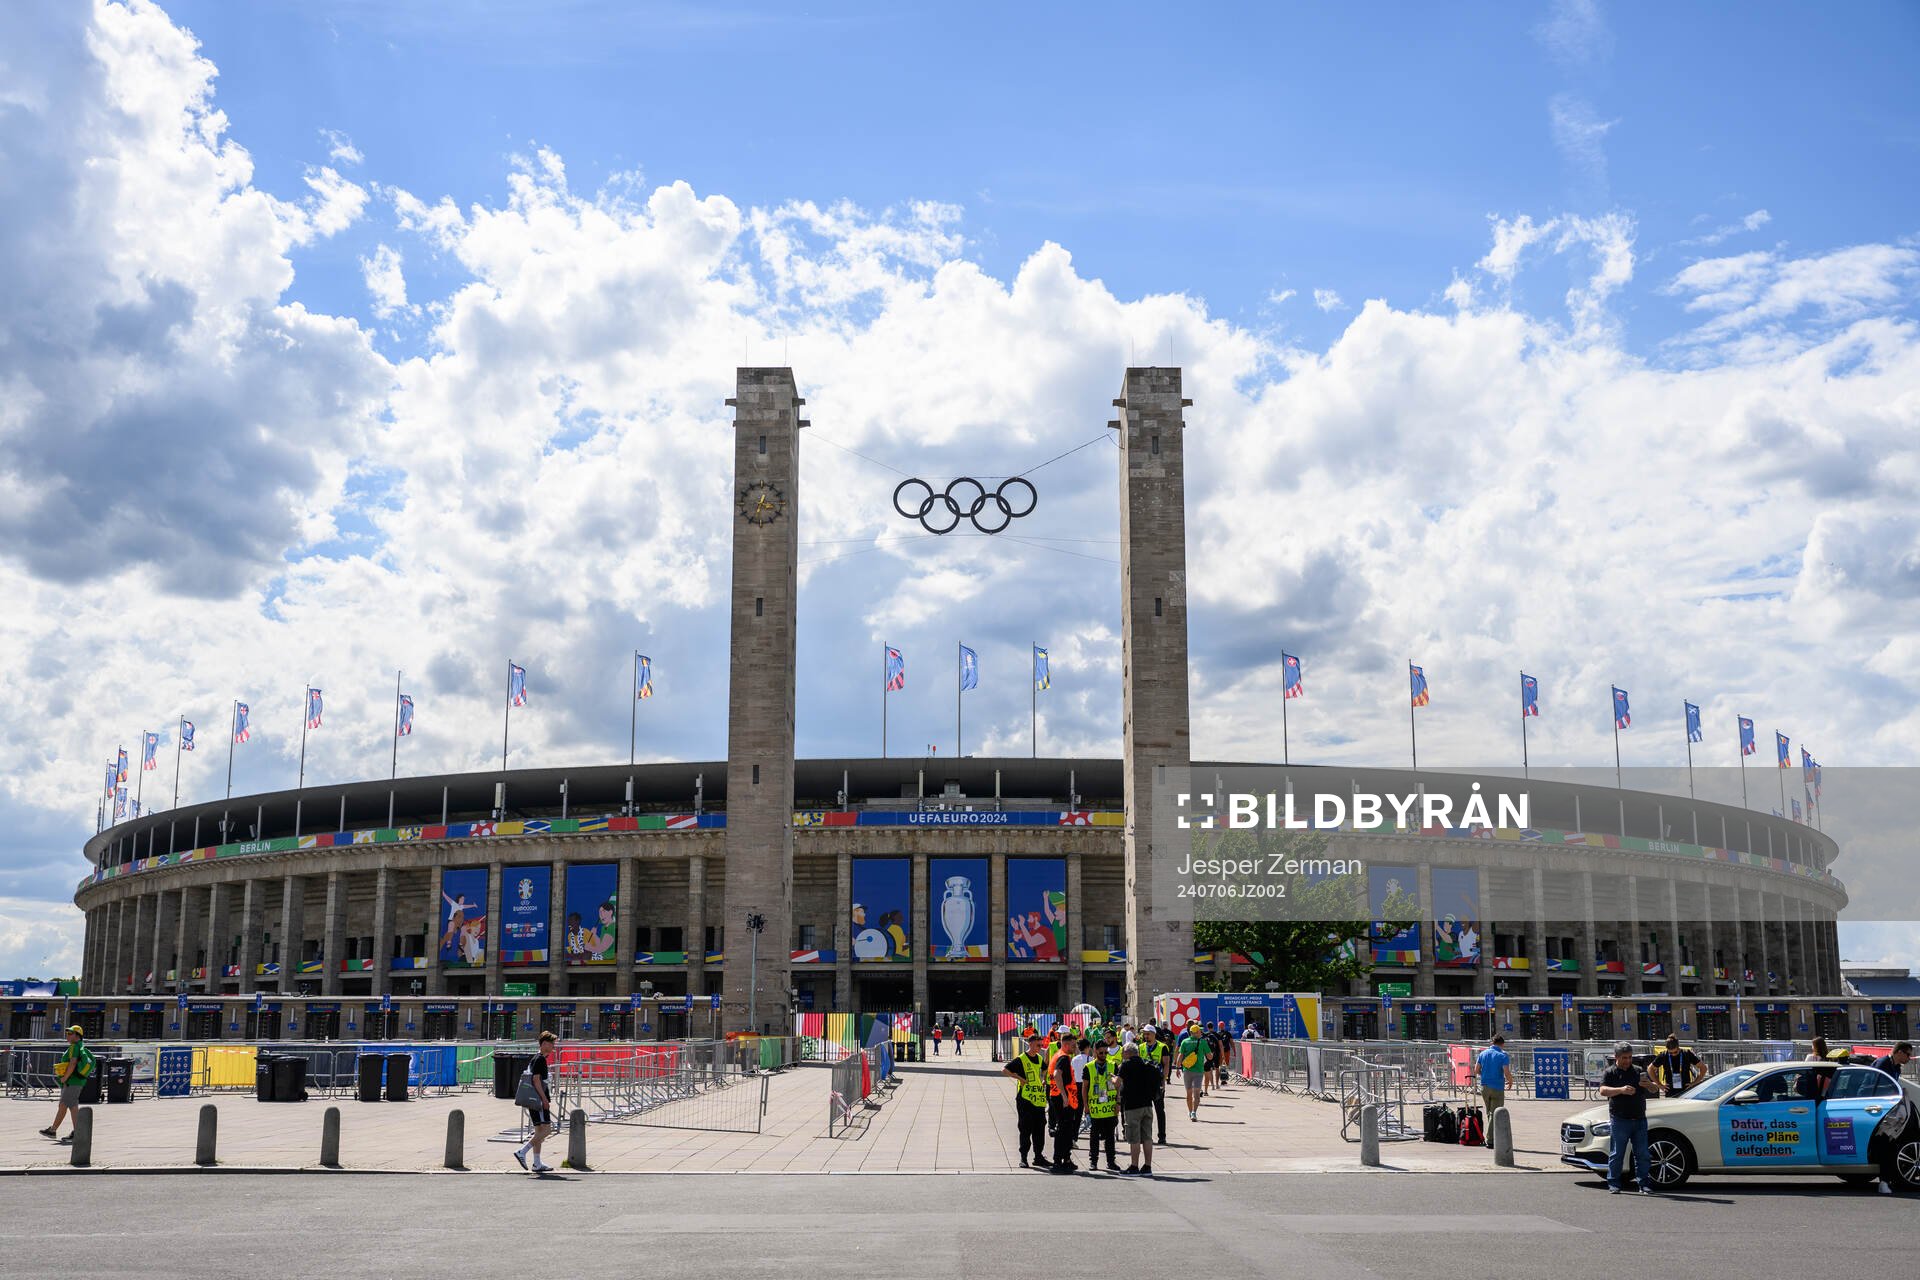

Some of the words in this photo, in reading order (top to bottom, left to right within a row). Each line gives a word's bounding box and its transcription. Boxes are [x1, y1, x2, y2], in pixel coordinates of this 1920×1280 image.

[909, 813, 941, 823] UEFA
[943, 813, 978, 823] EURO
[980, 813, 1008, 823] 2024
[240, 841, 271, 854] BERLIN
[1648, 841, 1680, 854] BERLIN
[1731, 1119, 1767, 1129] Dafür,
[1770, 1119, 1797, 1128] dass
[1731, 1132, 1764, 1141] deine
[1767, 1132, 1799, 1142] Pläne
[1736, 1145, 1796, 1156] aufgehen.
